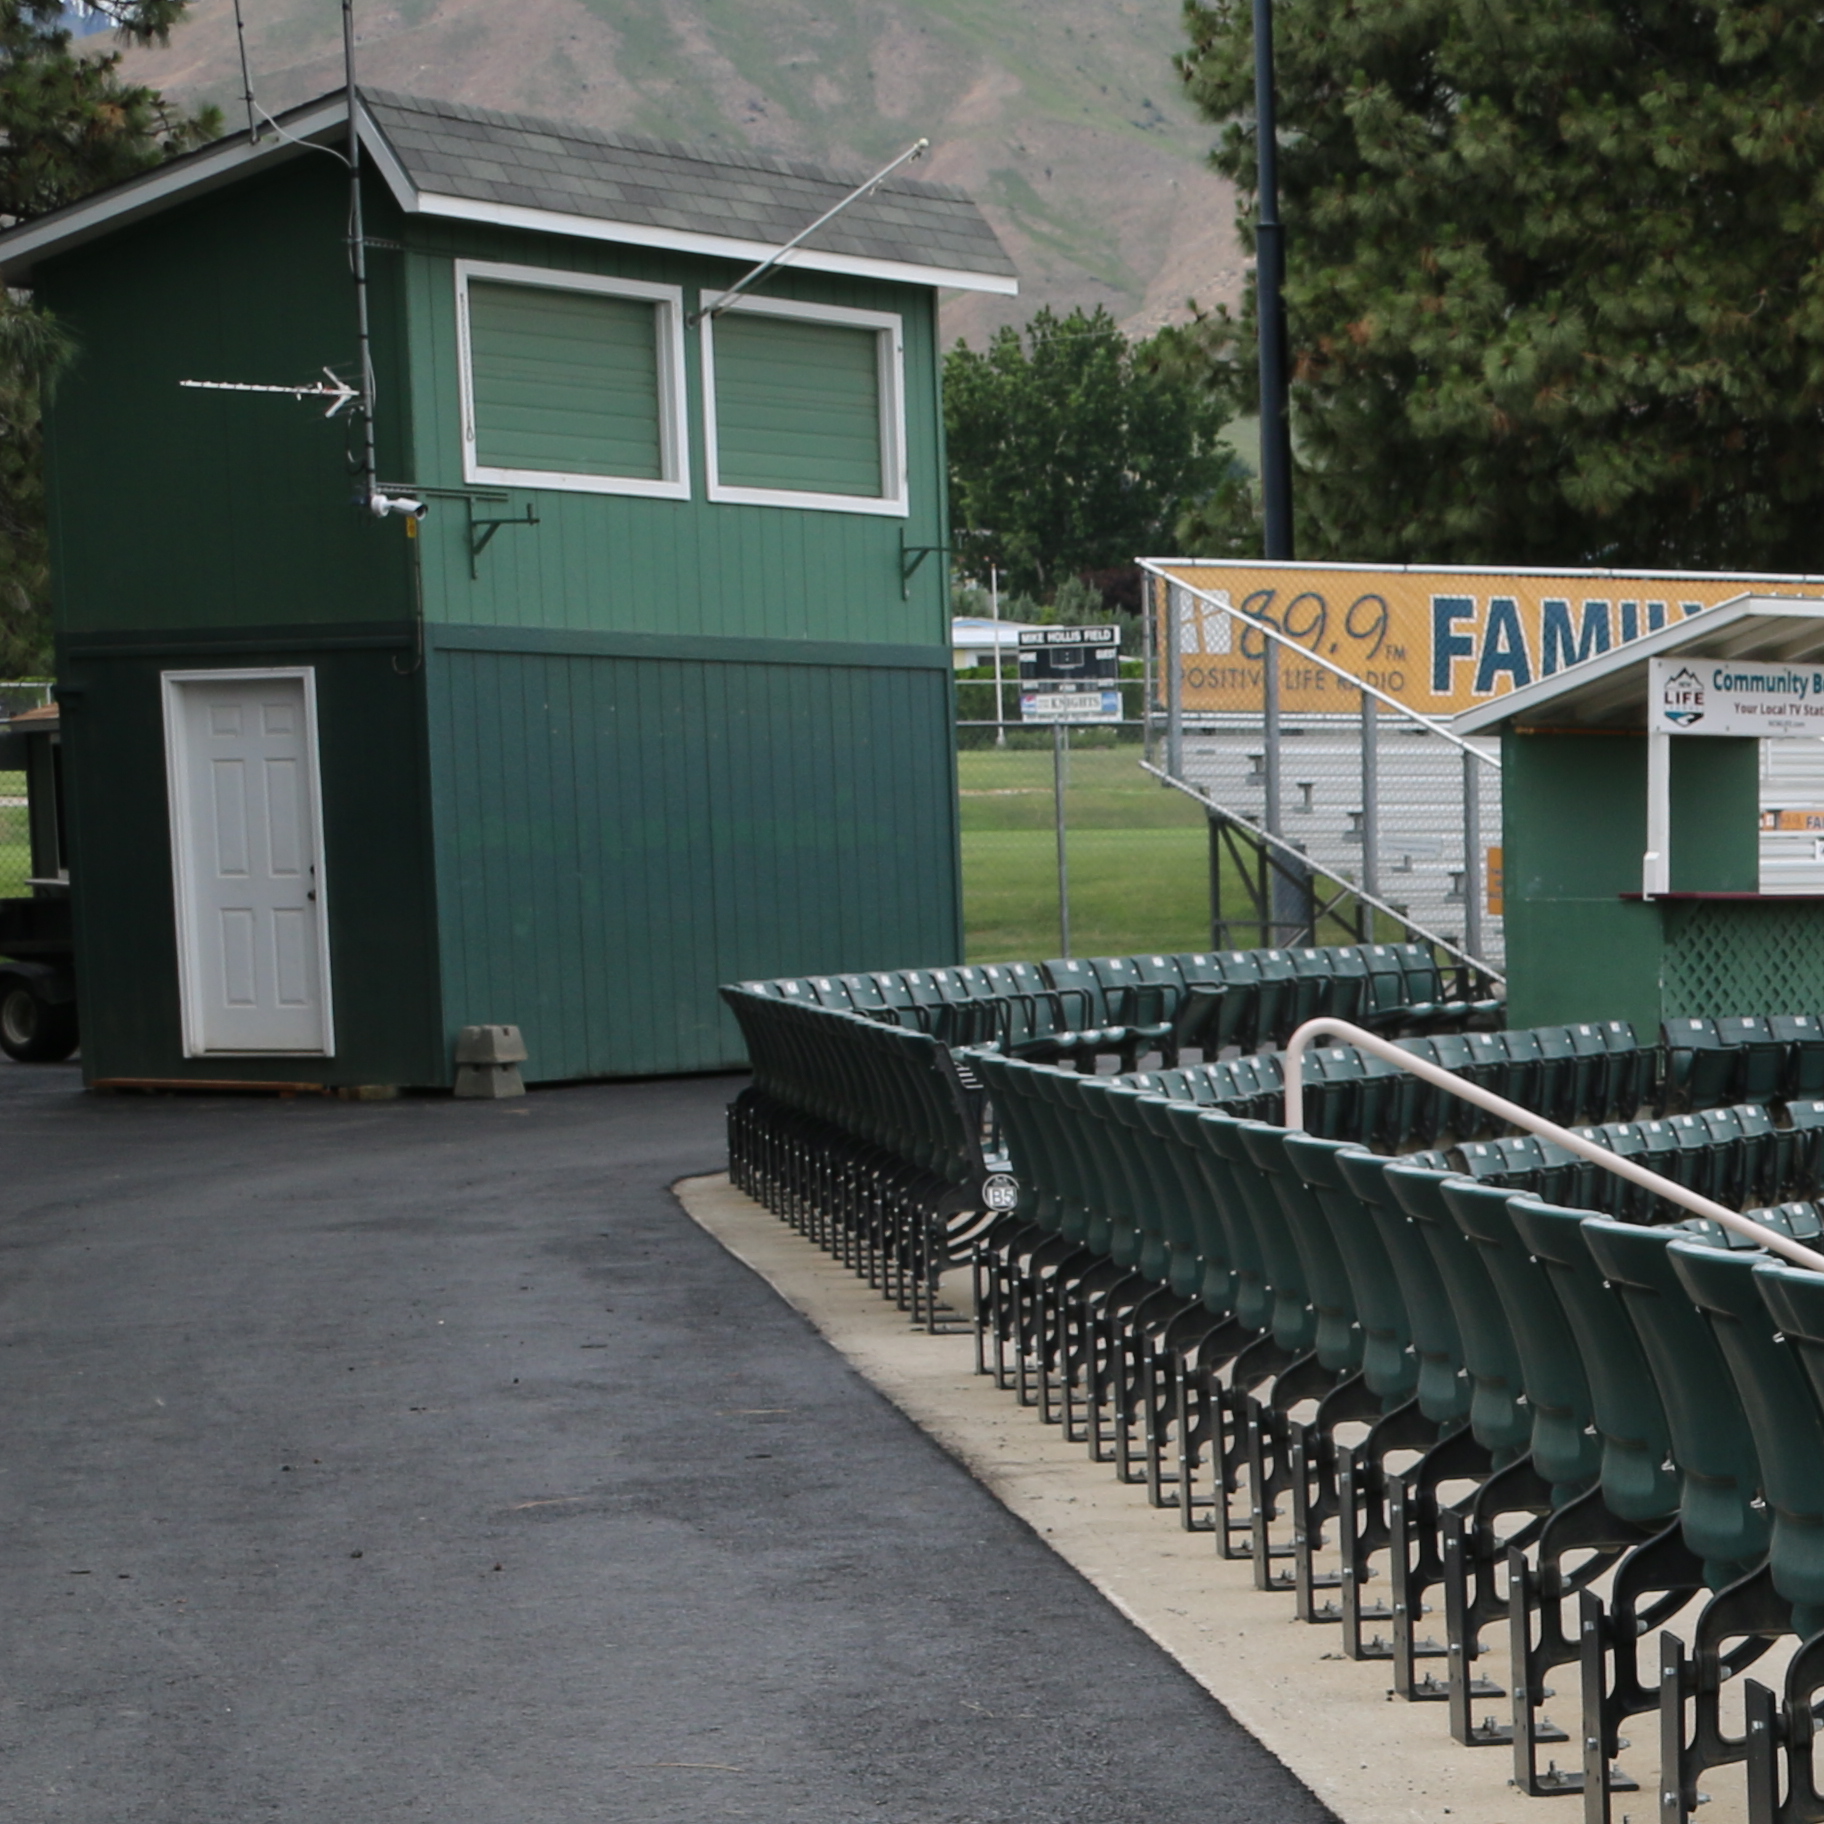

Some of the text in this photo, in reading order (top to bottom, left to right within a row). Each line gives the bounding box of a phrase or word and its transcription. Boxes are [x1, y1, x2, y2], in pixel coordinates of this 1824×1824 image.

[1240, 589, 1407, 661] 89.9 FM
[1084, 629, 1112, 641] FIELD
[1180, 667, 1263, 689] OSITIV
[1285, 670, 1325, 690] LIFE
[1713, 669, 1809, 700] Community
[1664, 691, 1704, 705] LIFE
[1734, 703, 1759, 715] Your
[1760, 703, 1786, 716] Local
[1789, 704, 1802, 716] TV
